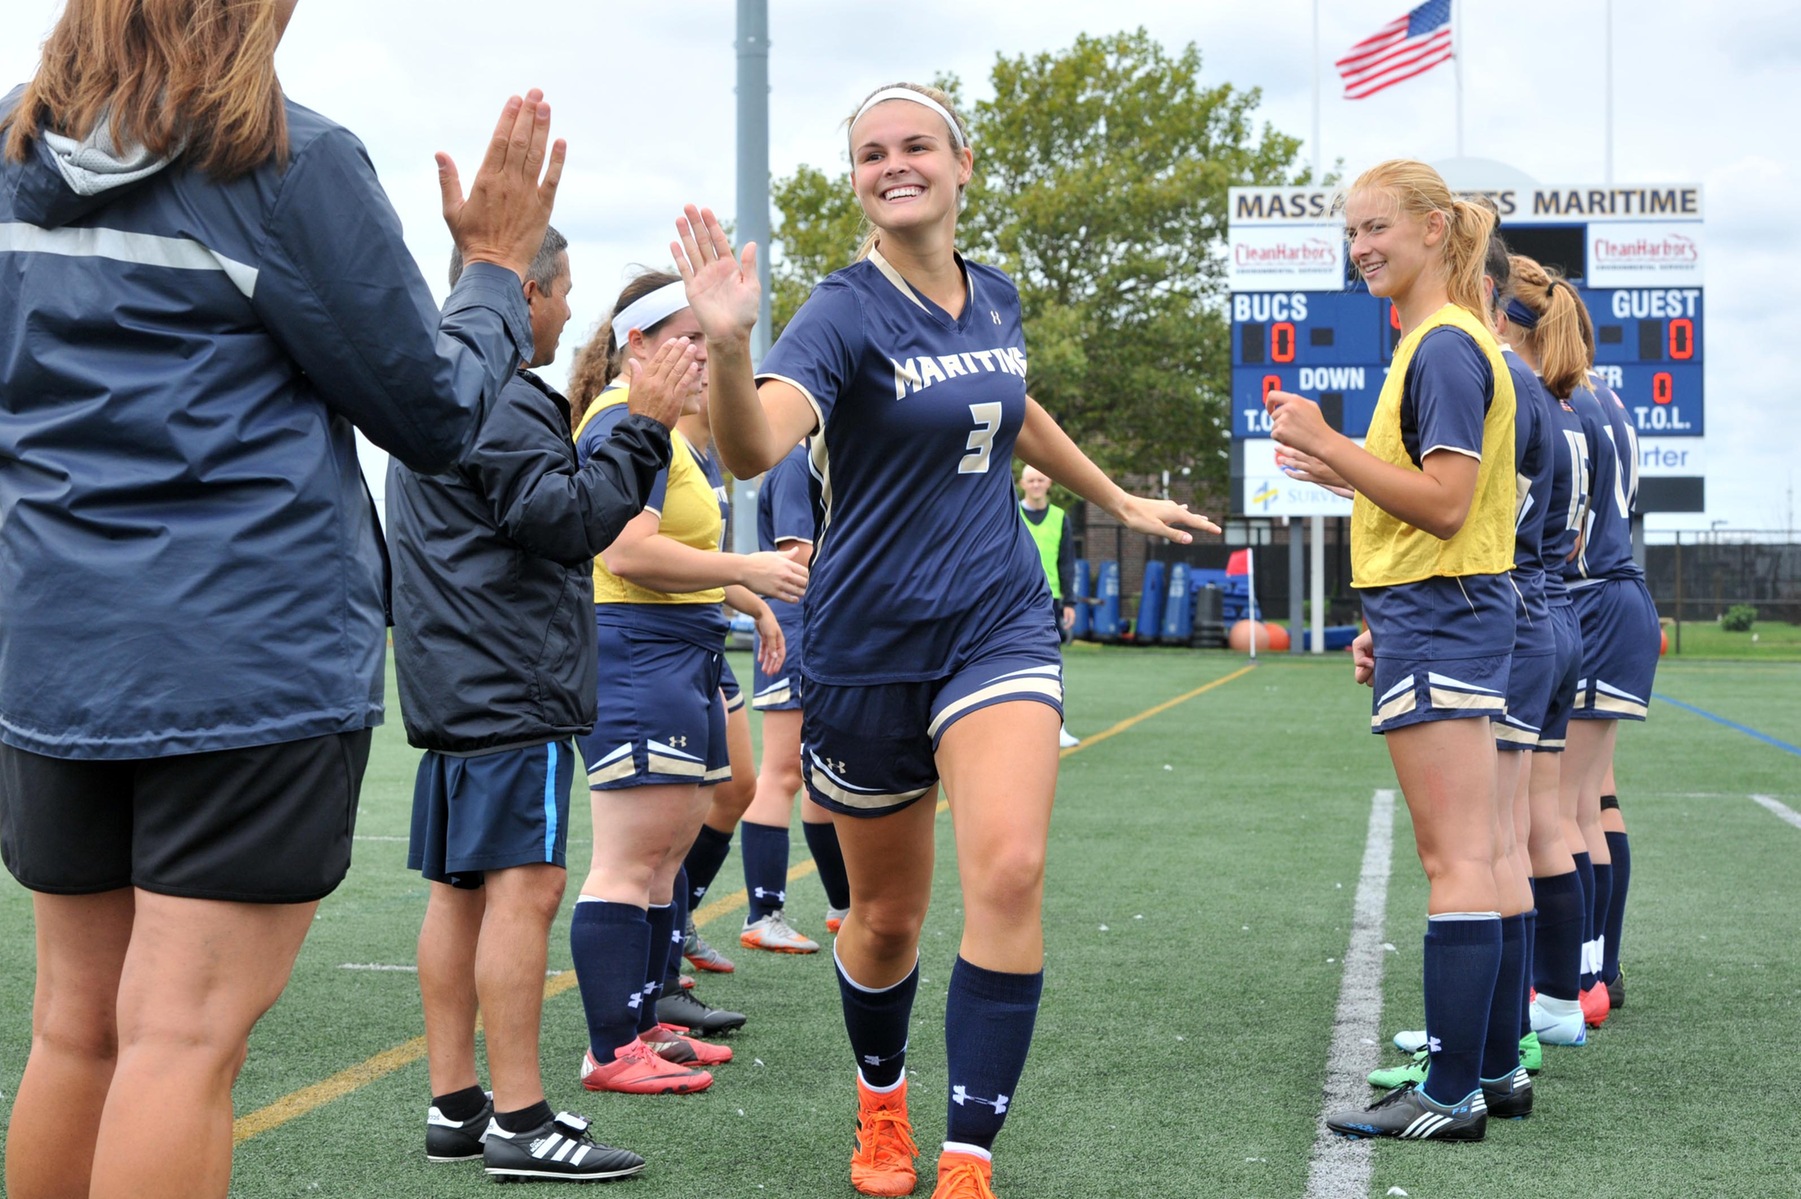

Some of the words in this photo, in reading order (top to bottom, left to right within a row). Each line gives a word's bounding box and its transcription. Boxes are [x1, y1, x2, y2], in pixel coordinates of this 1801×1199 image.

[1533, 189, 1697, 214] MARITIME
[1234, 293, 1308, 321] BUCS
[1612, 289, 1700, 318] GUEST
[1271, 322, 1295, 362] 0
[1669, 318, 1693, 360] 0
[1299, 366, 1365, 390] DOWN
[1653, 372, 1672, 404] 0
[1243, 409, 1275, 432] T.O
[1633, 406, 1691, 430] T.O.L.
[957, 401, 1003, 474] 3
[1638, 444, 1689, 467] rter
